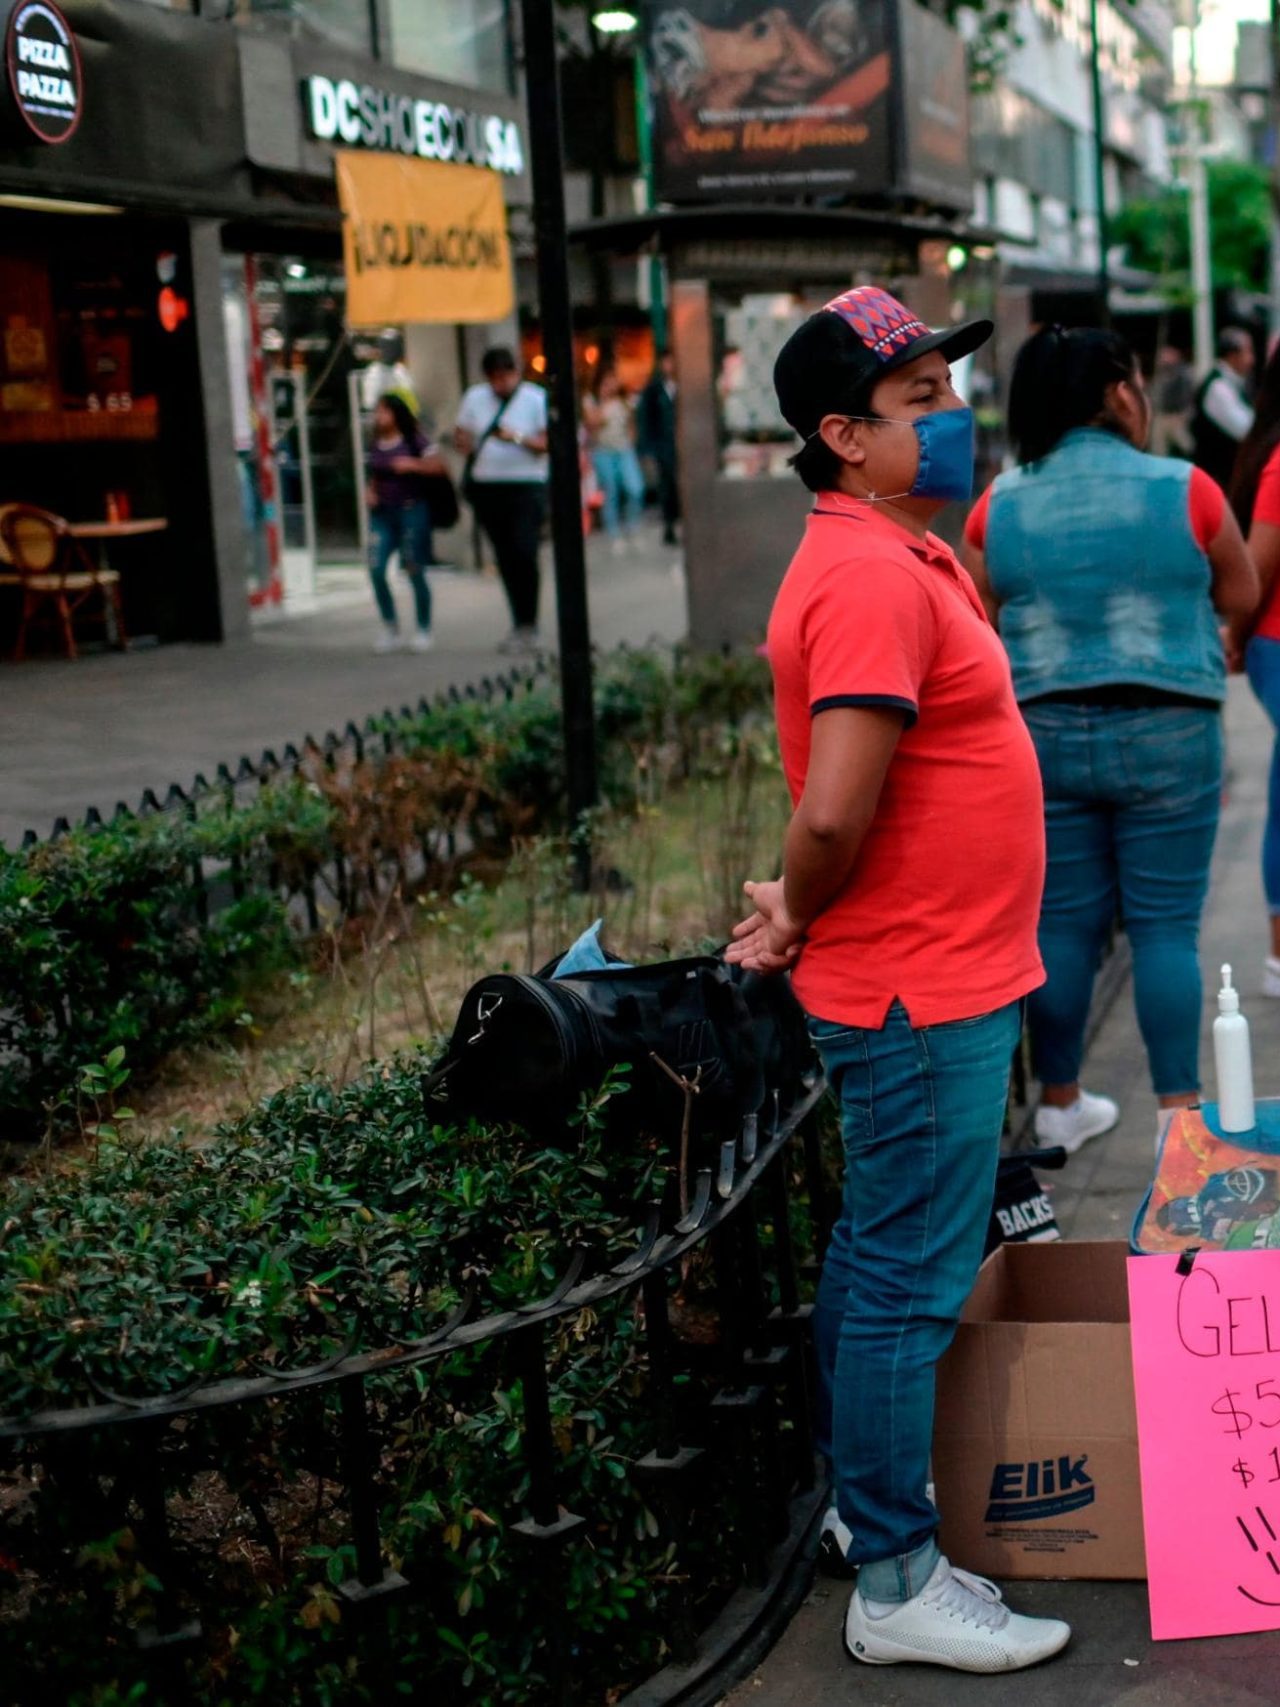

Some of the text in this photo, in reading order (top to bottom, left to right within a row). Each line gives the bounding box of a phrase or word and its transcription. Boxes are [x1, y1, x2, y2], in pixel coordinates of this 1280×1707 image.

[17, 35, 71, 72] PIZZA
[17, 69, 77, 107] PAZZA
[996, 1194, 1054, 1237] BACKS
[989, 1454, 1093, 1500] Elik
